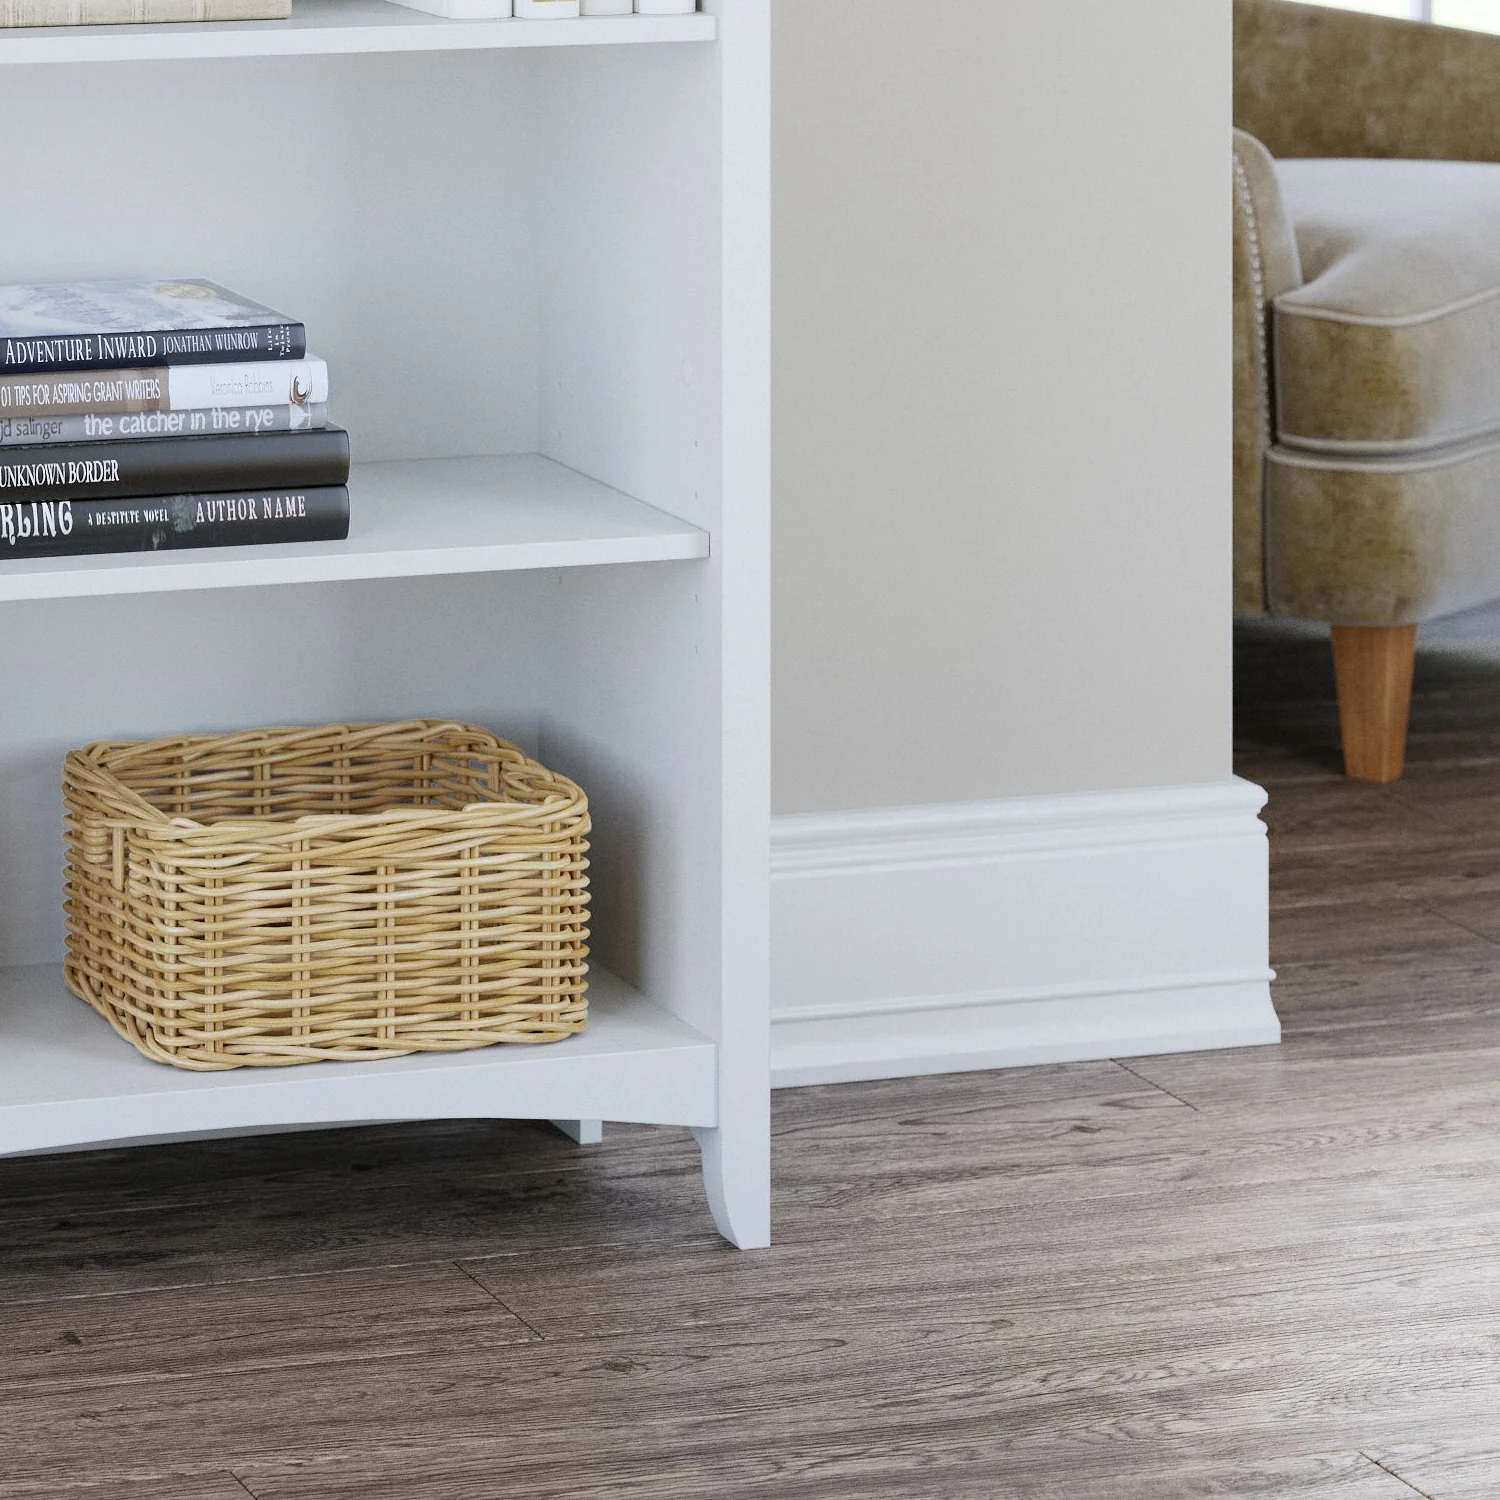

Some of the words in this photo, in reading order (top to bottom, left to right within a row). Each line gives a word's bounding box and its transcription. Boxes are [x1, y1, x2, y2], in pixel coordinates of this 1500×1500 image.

[5, 339, 93, 364] ADVENTURE
[98, 334, 157, 360] INWARD
[162, 334, 213, 356] JONATHAN
[215, 332, 259, 351] WUNROW
[14, 385, 31, 406] TIPS
[33, 384, 50, 405] FOR
[52, 382, 92, 404] ASPIRING
[93, 380, 124, 402] GRANT
[124, 378, 161, 400] WRITERS
[0, 418, 12, 443] jd
[16, 417, 63, 440] salinger
[84, 413, 113, 436] the
[119, 409, 185, 434] catcher
[189, 408, 206, 431] in
[211, 407, 241, 430] the
[245, 408, 275, 433] rye
[68, 459, 120, 485] BORDER
[195, 498, 258, 524] AUTHOR
[262, 495, 307, 520] NAME
